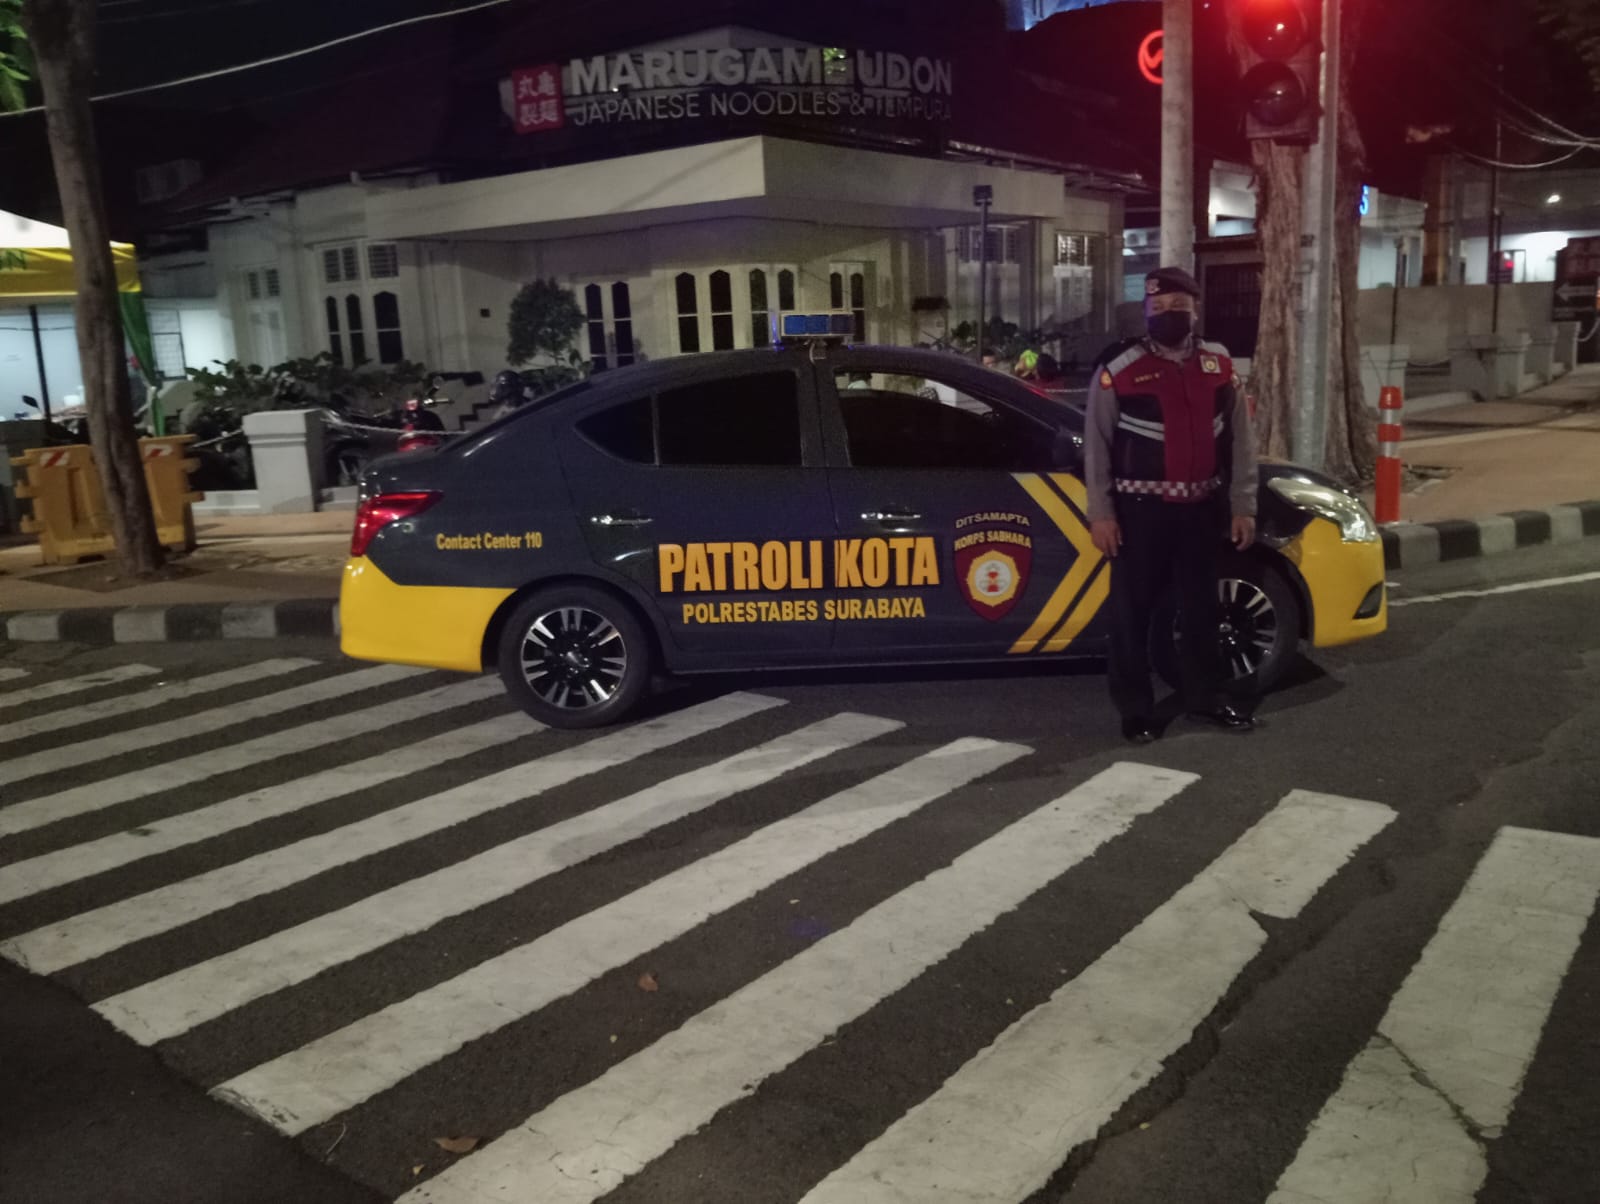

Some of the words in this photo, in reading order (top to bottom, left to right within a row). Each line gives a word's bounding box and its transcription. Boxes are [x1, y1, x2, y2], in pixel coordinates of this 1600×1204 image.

[857, 49, 953, 95] UDON
[575, 93, 700, 126] JAPANESE
[711, 92, 841, 116] NOODLES
[850, 94, 867, 116] &
[875, 96, 953, 121] TEMPURA
[955, 512, 1030, 529] DITSAMAPTA
[436, 533, 482, 550] Contact
[484, 532, 522, 550] Center
[524, 531, 543, 550] 110
[954, 531, 985, 551] KORPS
[987, 530, 1032, 549] SABHARA
[658, 540, 824, 593] PATROLI
[834, 536, 941, 588] KOTA
[682, 600, 818, 624] POLRESTABES
[823, 597, 926, 620] SURABAYA
